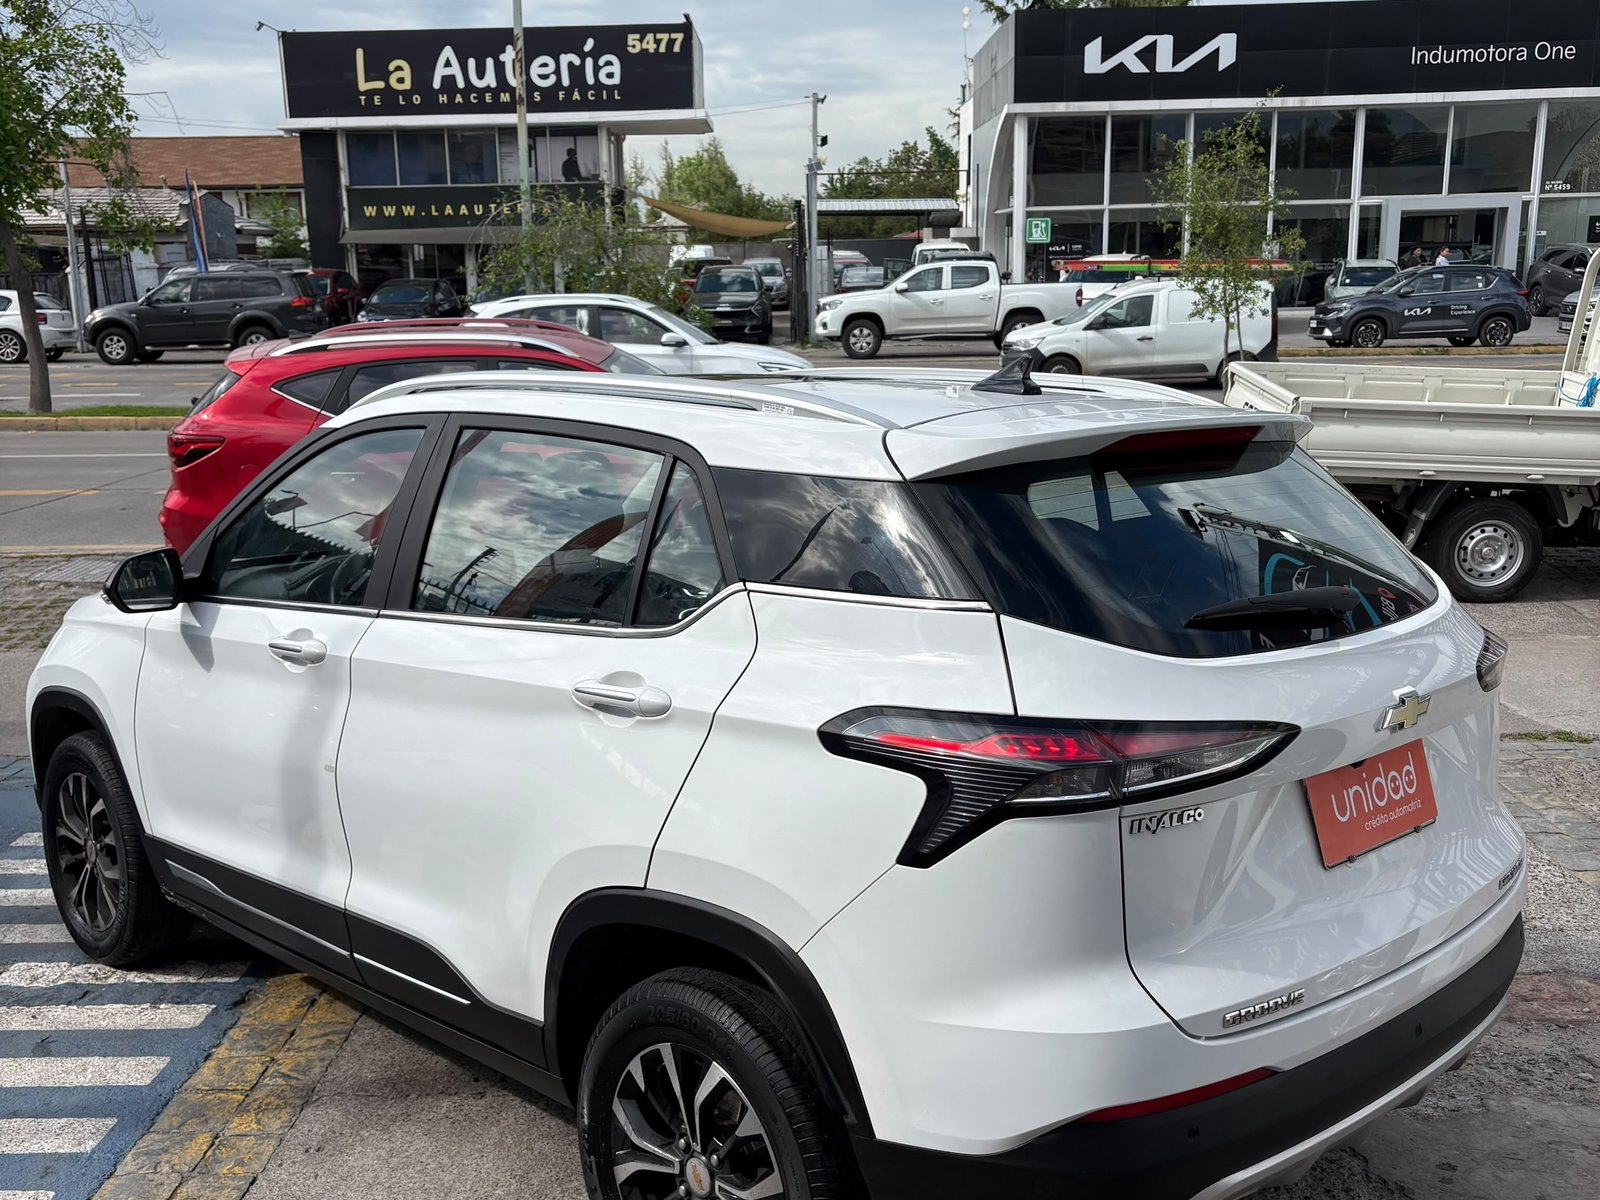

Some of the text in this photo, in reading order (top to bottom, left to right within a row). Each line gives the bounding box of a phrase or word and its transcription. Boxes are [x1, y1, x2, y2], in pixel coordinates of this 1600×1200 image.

[626, 33, 684, 54] 5477
[1410, 42, 1577, 66] Indumotora One
[356, 38, 622, 92] La Autería
[359, 87, 622, 106] TE LO HACEMS FÁCIL
[1331, 751, 1417, 823] unidad
[1130, 807, 1204, 834] INALCO
[1364, 797, 1422, 831] crédito automotriz
[1223, 988, 1304, 1029] GROOVE
